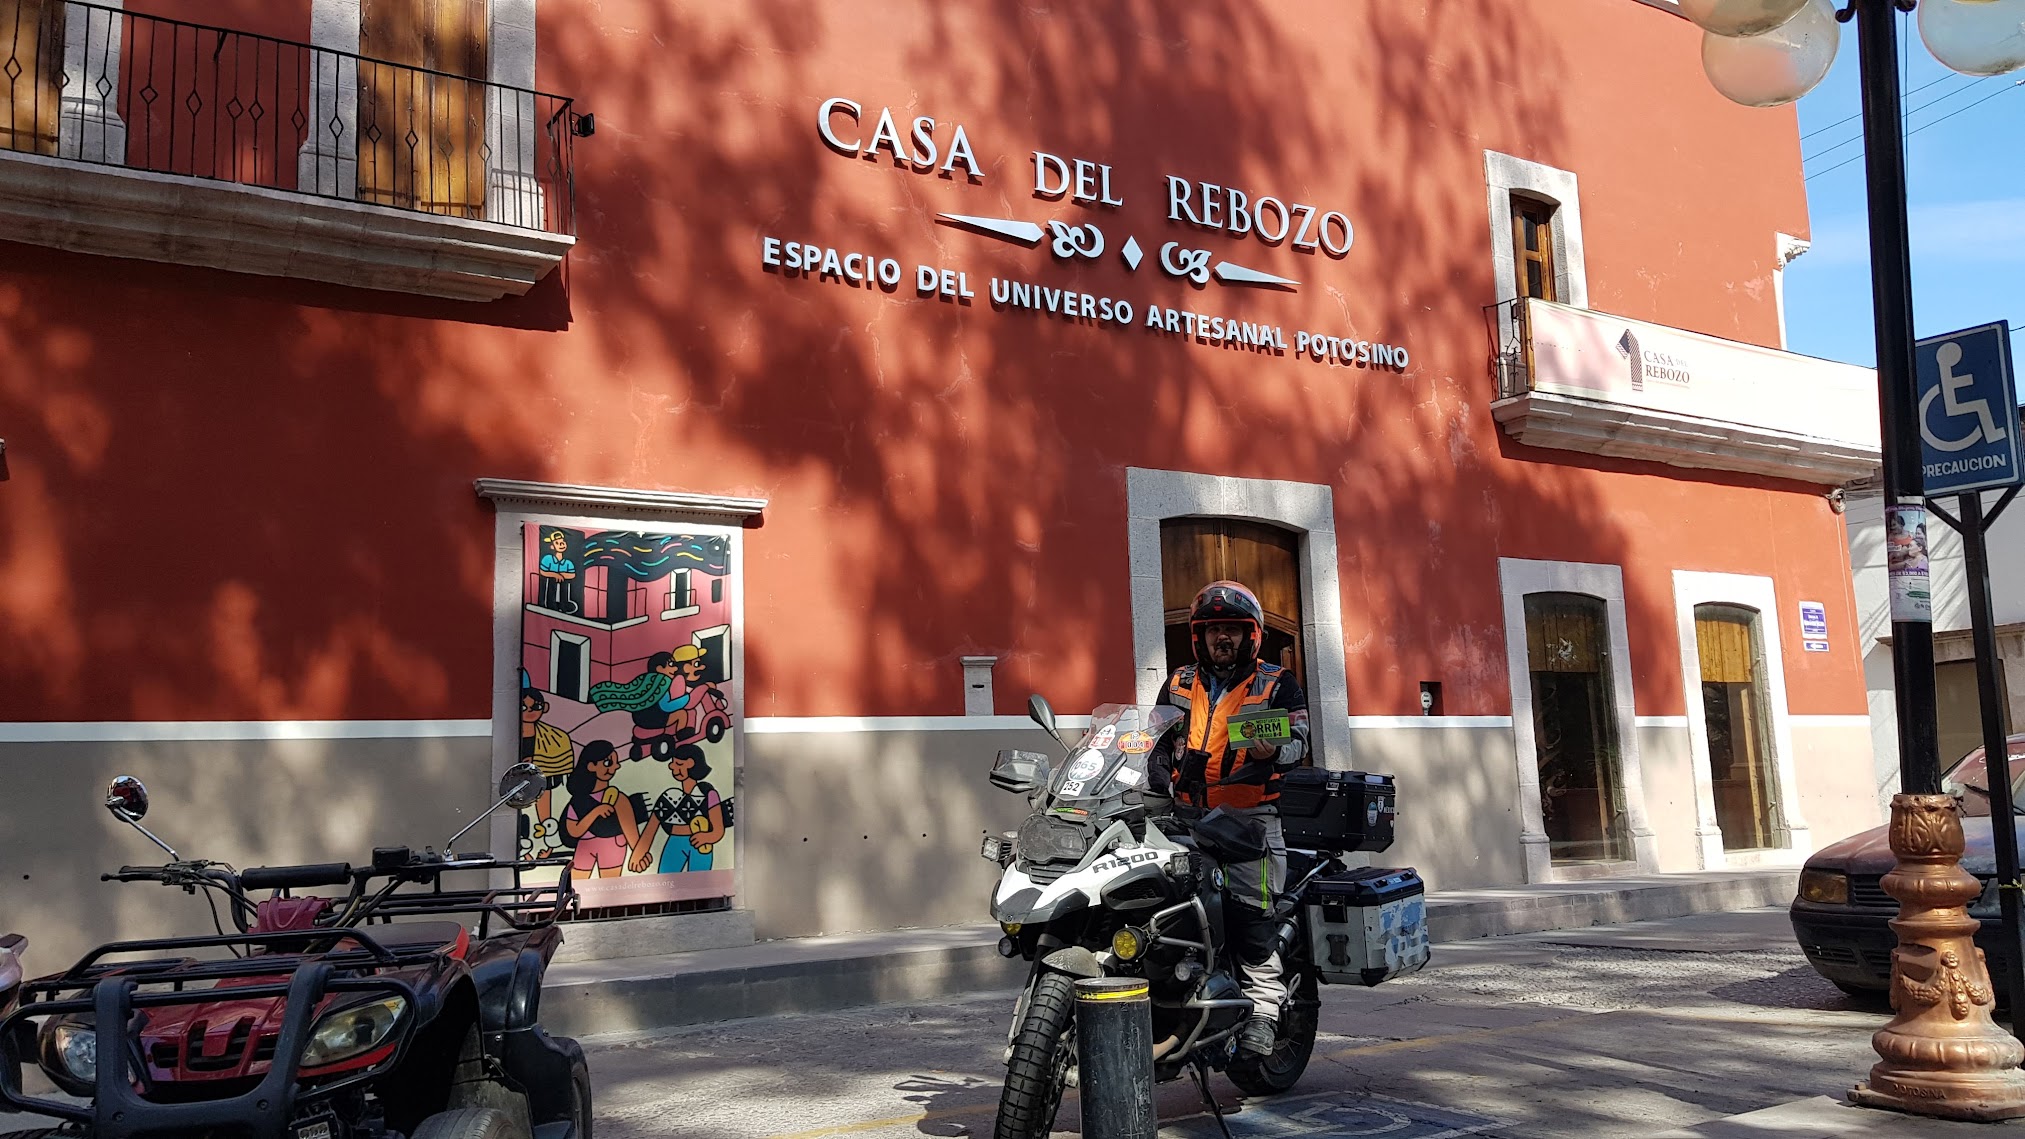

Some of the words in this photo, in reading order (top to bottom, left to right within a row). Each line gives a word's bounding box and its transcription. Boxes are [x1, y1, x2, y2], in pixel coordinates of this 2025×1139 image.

[817, 97, 985, 177] CASA
[1033, 150, 1123, 207] DEL
[1166, 174, 1354, 255] REBOZO
[763, 236, 901, 286] ESPACIO
[916, 264, 975, 298] DEL
[990, 277, 1134, 325] UNIVERSO
[1146, 304, 1288, 349] ARTESANAL
[1297, 330, 1409, 368] POTOSINO
[1644, 350, 1674, 367] CASA
[1675, 358, 1688, 368] DEL
[1645, 364, 1690, 384] REBOZO
[1256, 722, 1282, 734] RRM
[1063, 781, 1081, 792] 252
[1092, 851, 1159, 874] R1200
[585, 880, 676, 893] www.casadelrebozo.org
